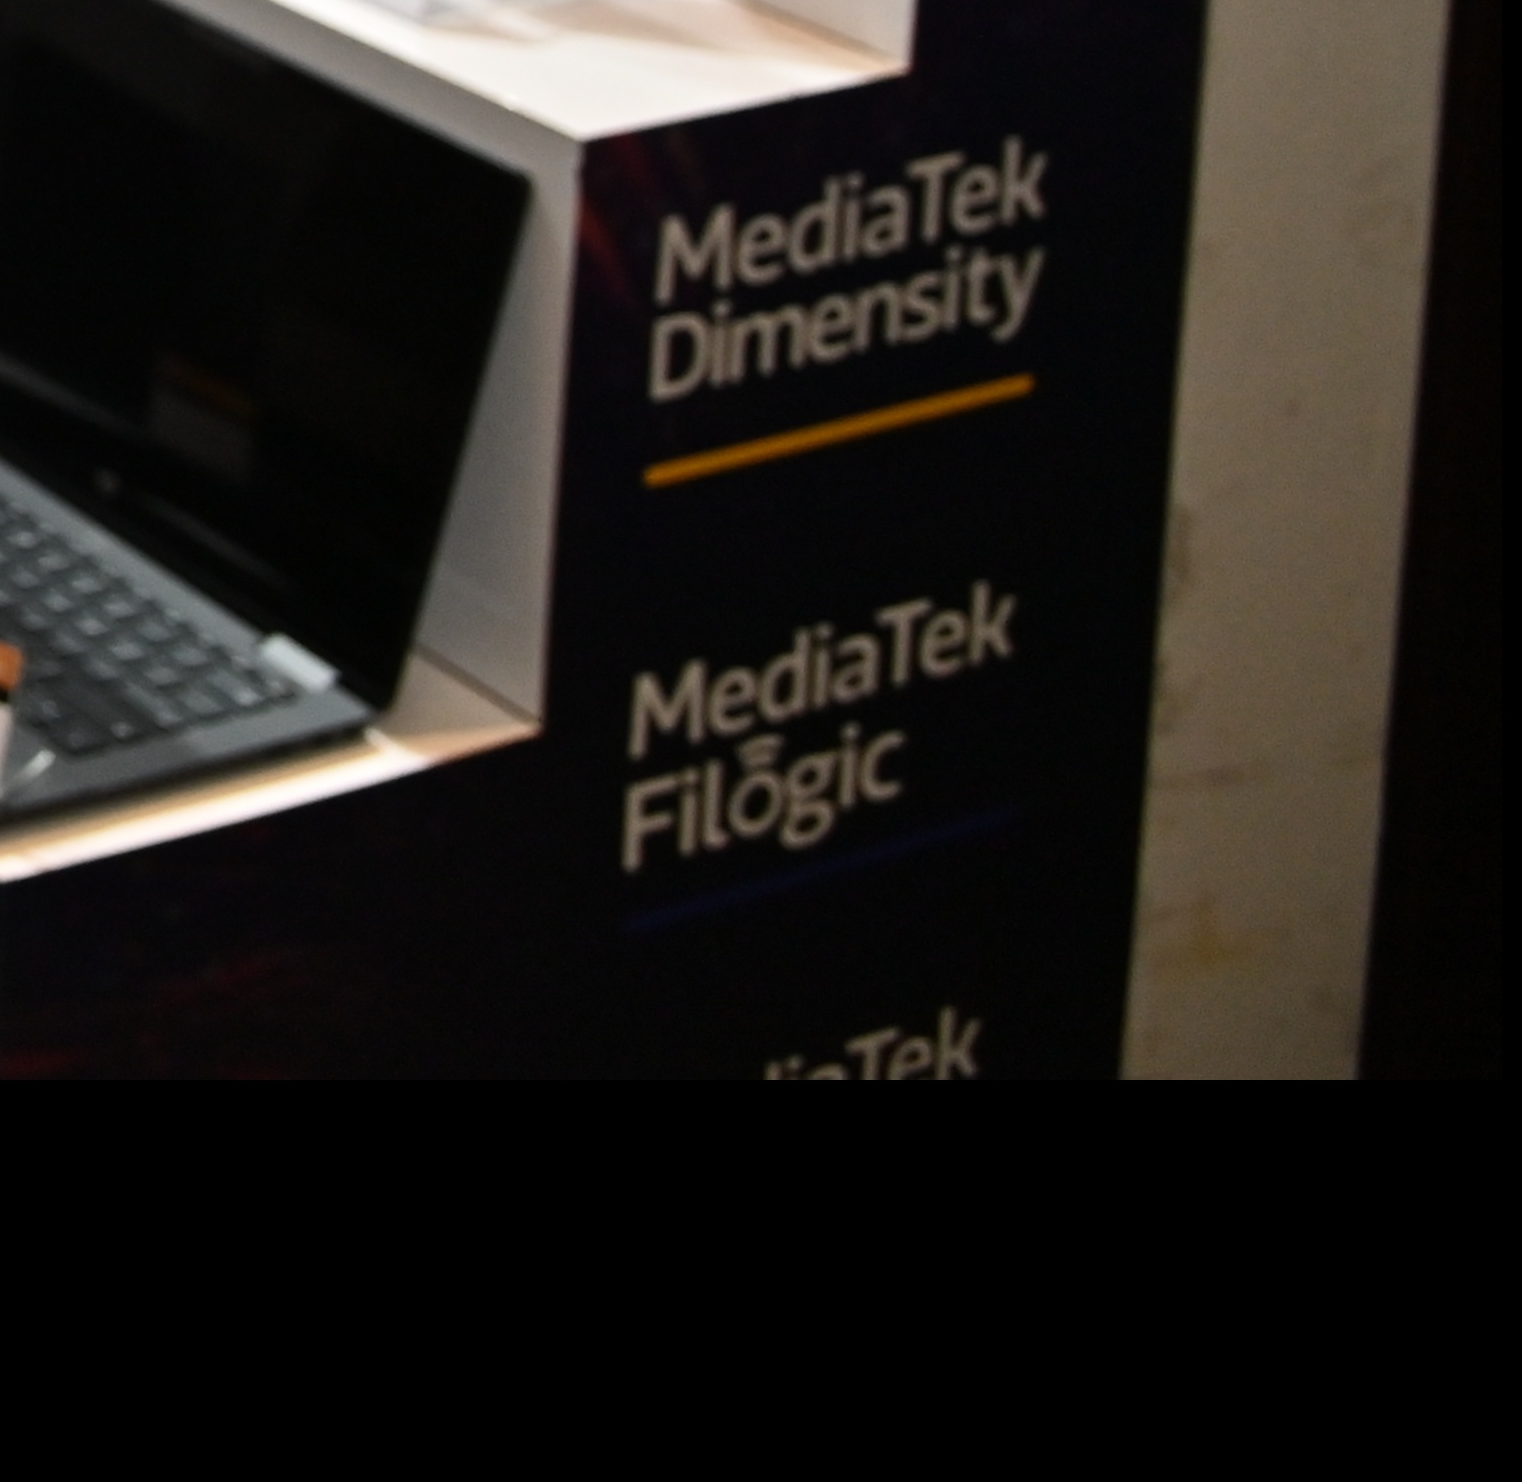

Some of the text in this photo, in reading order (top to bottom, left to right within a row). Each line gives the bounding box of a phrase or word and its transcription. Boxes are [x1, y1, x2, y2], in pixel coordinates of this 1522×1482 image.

[653, 135, 1048, 305] MediaTek
[649, 245, 1045, 403] Dimensity
[629, 578, 1020, 758] MediaTek
